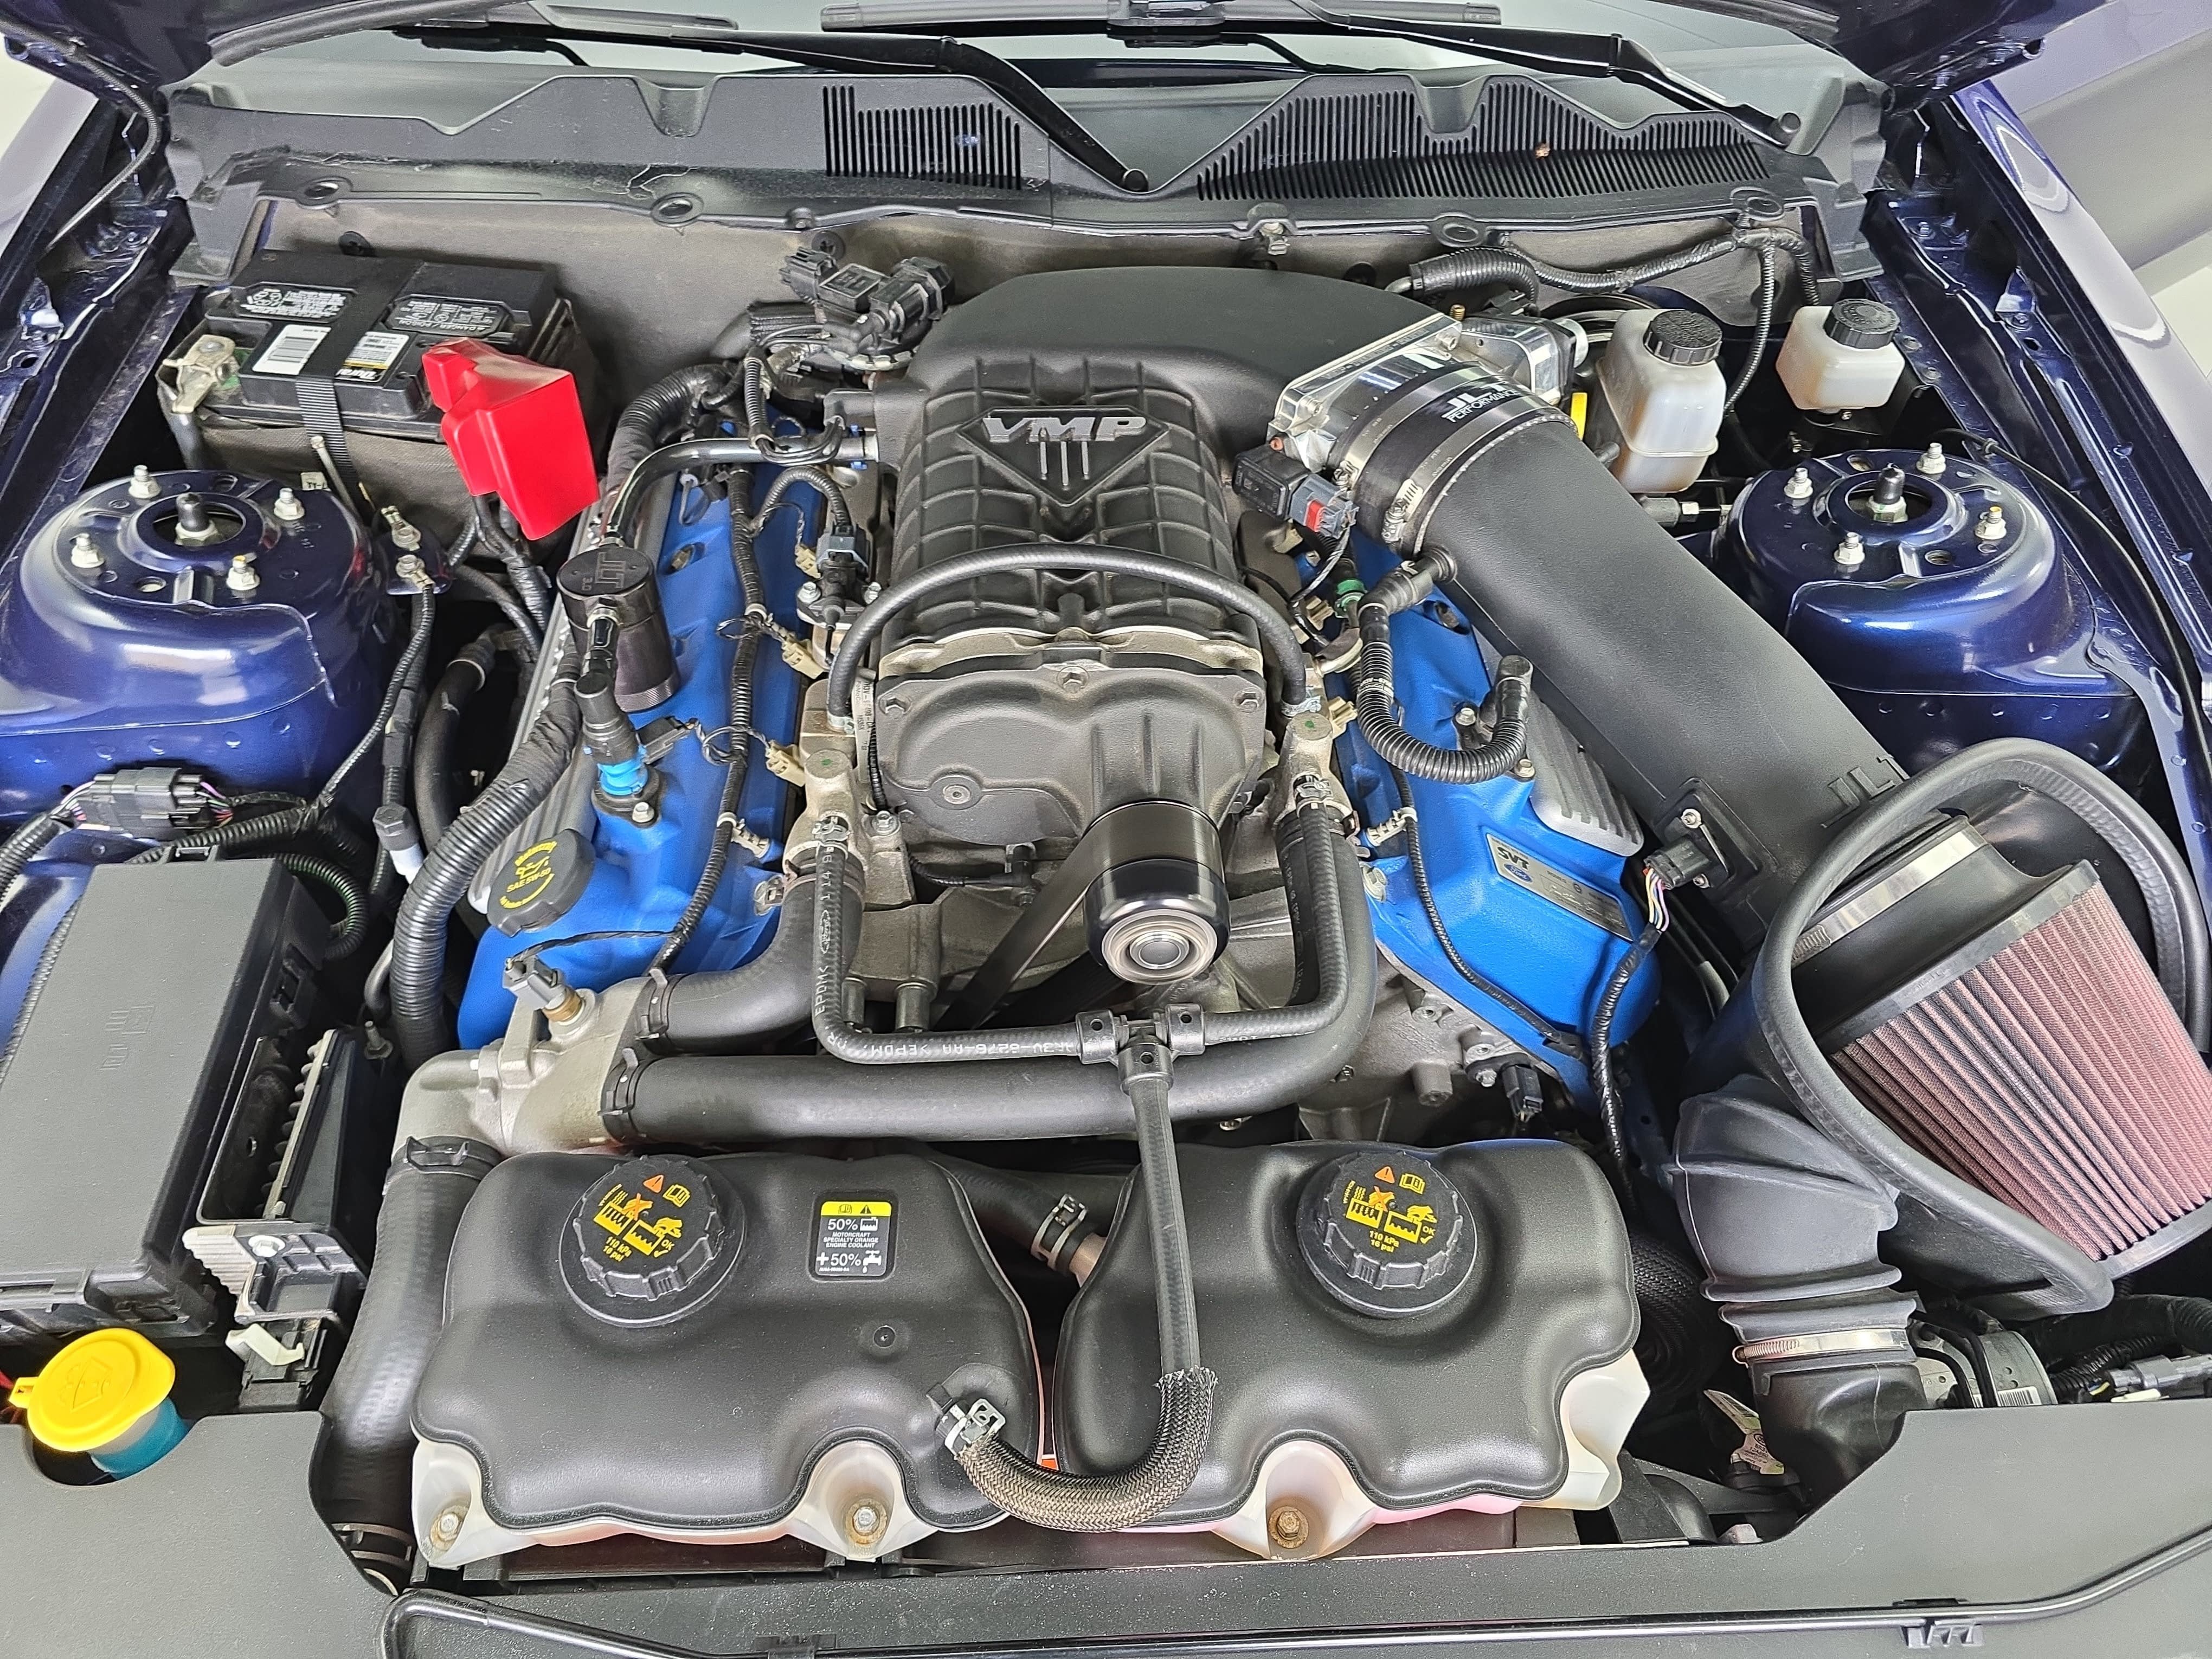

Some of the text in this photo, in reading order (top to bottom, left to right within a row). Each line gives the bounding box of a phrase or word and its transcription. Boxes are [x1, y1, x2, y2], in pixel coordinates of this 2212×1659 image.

[1441, 382, 1509, 419] JLT
[1446, 389, 1522, 423] PERFORMANCE
[982, 415, 1147, 443] VMP
[1496, 846, 1531, 870] SVT
[506, 879, 526, 893] SAE
[525, 867, 552, 885] 5W-50
[821, 871, 832, 887] 14
[827, 1218, 859, 1231] 50%
[1422, 1225, 1436, 1236] OK
[606, 1236, 633, 1258] 110 kPa
[661, 1238, 676, 1251] OK
[1369, 1230, 1400, 1249] 110 kPa
[1370, 1239, 1395, 1253] 16 psi
[609, 1251, 625, 1262] psi
